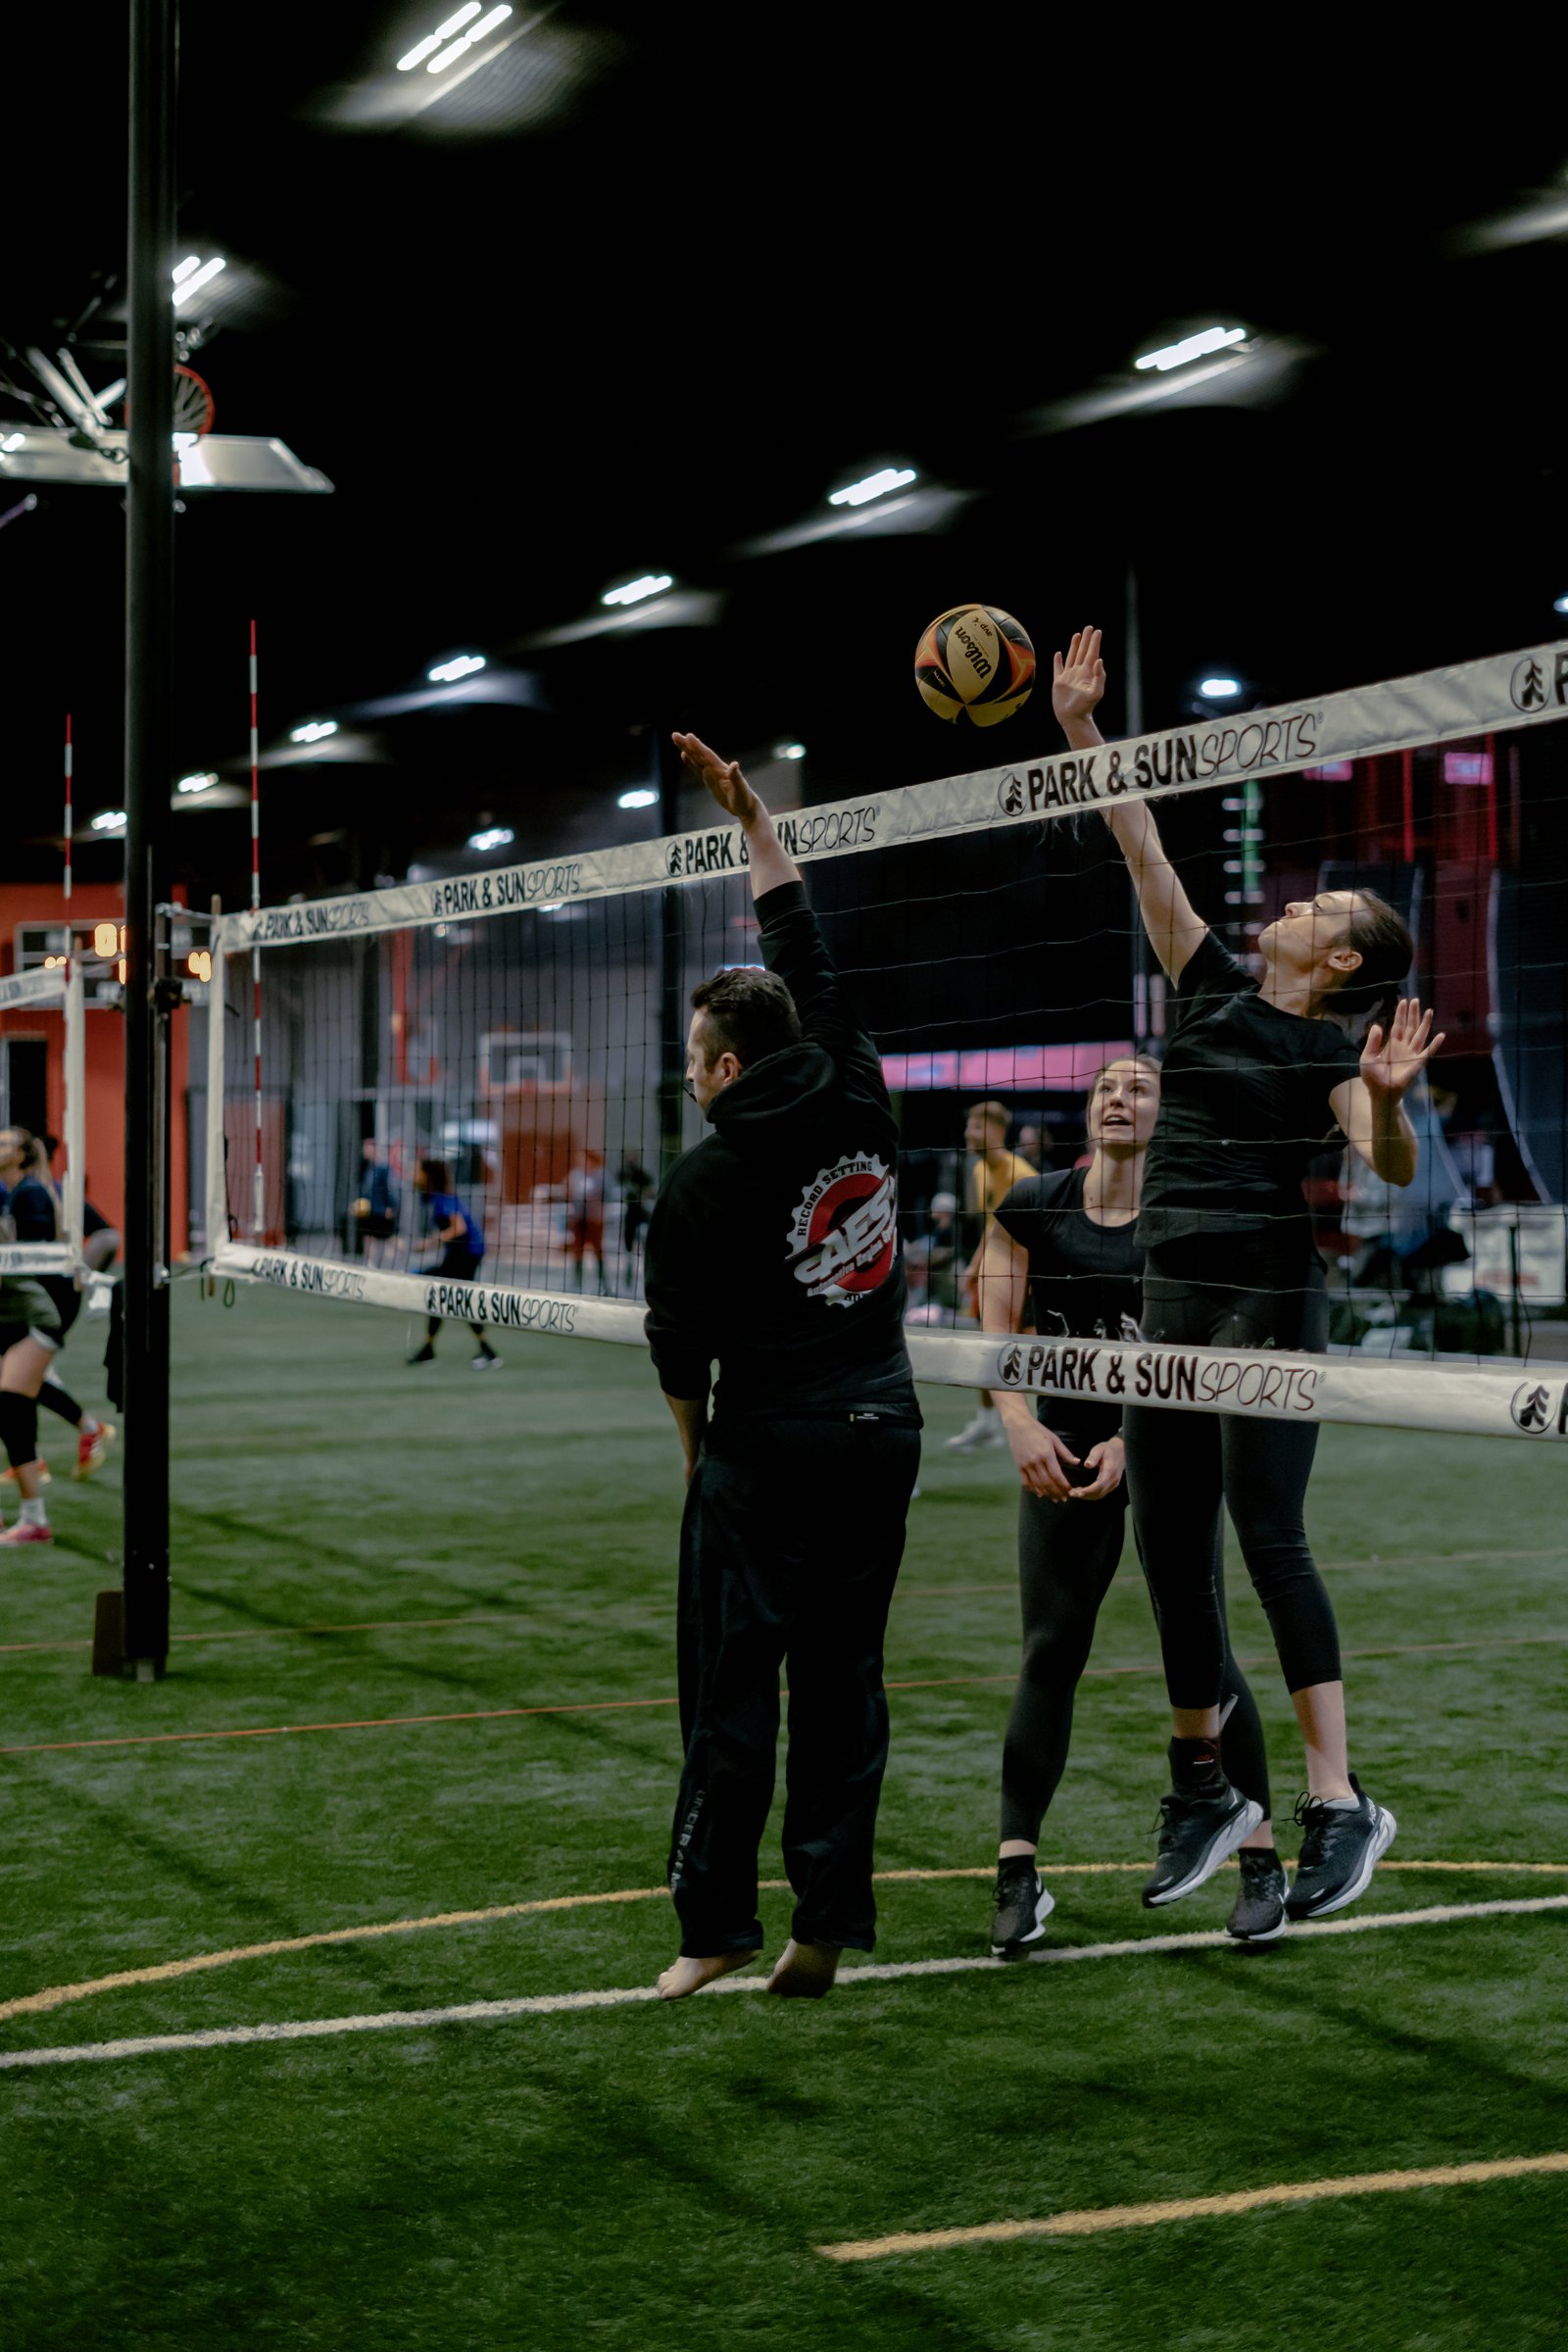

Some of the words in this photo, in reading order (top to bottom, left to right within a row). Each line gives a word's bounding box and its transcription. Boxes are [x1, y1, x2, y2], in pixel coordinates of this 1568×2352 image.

[956, 626, 992, 679] Wilson
[1027, 755, 1100, 811] PARK
[1106, 751, 1127, 796] &
[685, 831, 734, 874] PARK
[443, 879, 479, 914] PARK
[482, 877, 492, 907] &
[797, 1185, 823, 1237] RECORD
[822, 1160, 872, 1186] SETTING
[439, 1285, 474, 1319] PARK
[478, 1290, 488, 1321] &
[1027, 1346, 1100, 1392] PARK
[1105, 1354, 1125, 1395] &
